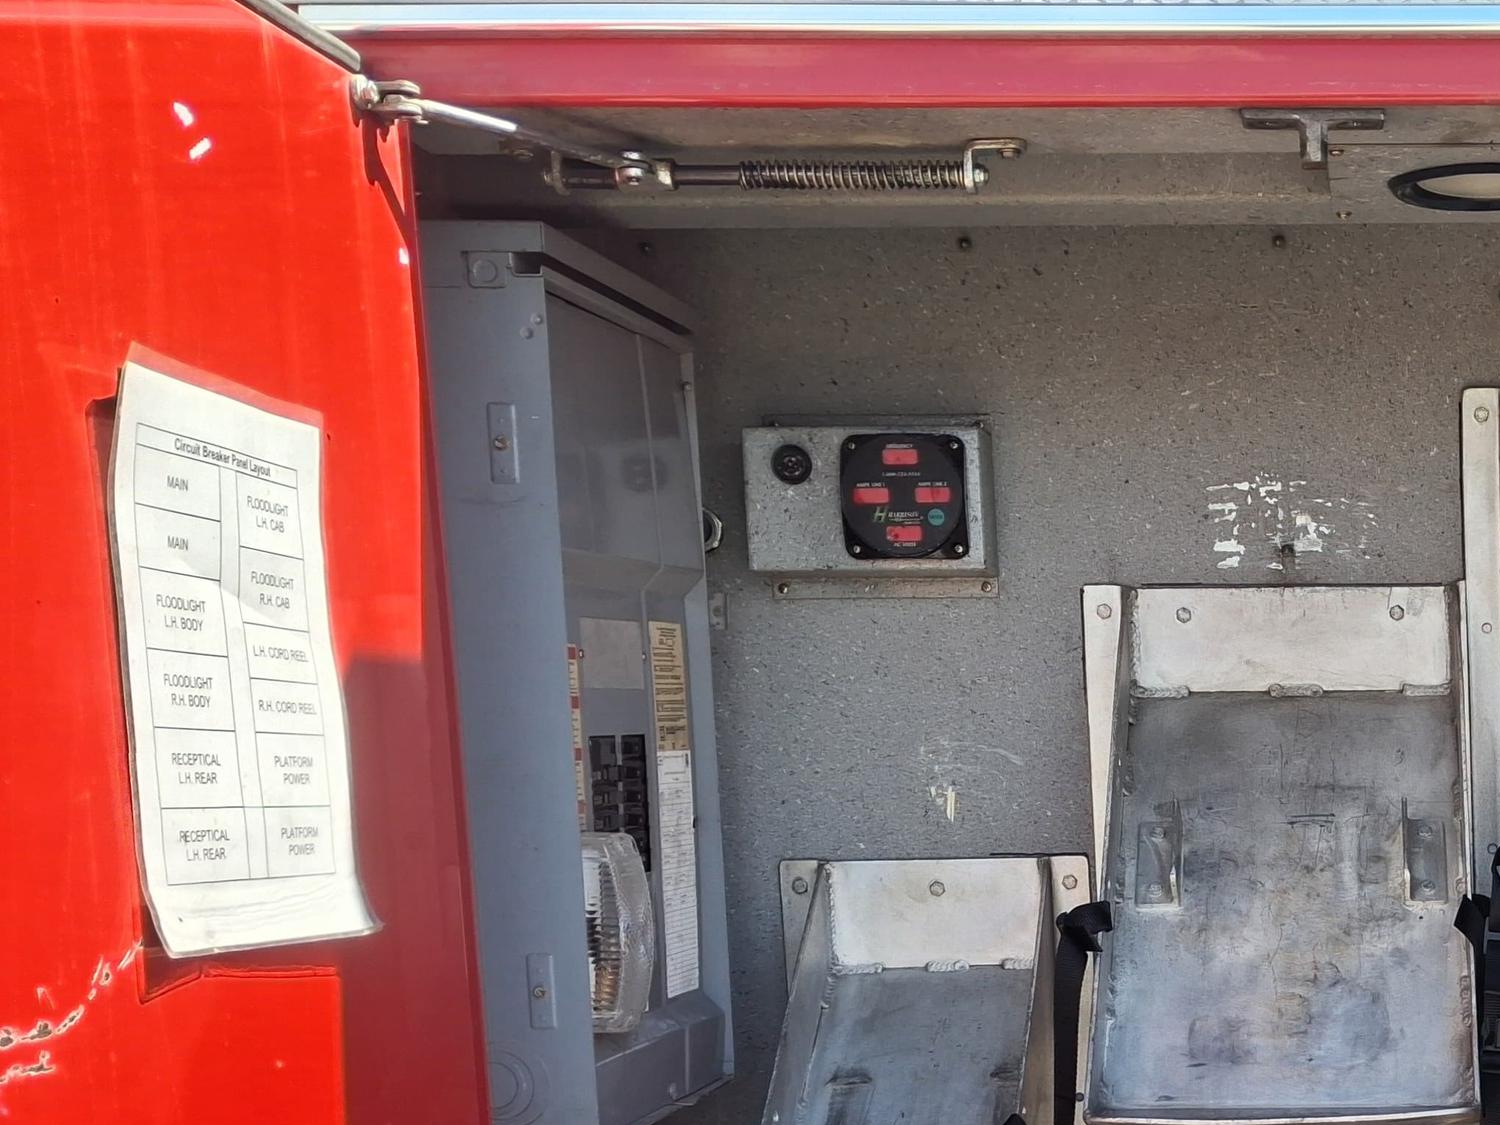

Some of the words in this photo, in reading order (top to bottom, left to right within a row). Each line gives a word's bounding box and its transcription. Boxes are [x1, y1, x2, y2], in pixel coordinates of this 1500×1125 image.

[174, 437, 201, 456] Circuit
[202, 444, 230, 464] Breaker
[231, 453, 249, 470] Panel
[249, 460, 271, 477] Layout
[167, 475, 189, 492] MAIN
[246, 495, 289, 518] FLOODLIGHT
[270, 519, 285, 534] CAB
[167, 535, 189, 551] MAIN
[250, 570, 294, 591] FLOODLIGHT
[156, 594, 206, 614] FLOODLIGHT
[275, 595, 291, 610] CAB
[180, 617, 204, 632] BODY
[268, 647, 290, 661] CORD
[290, 650, 310, 663] REEL
[163, 673, 213, 690] FLOODLIGHT
[171, 693, 187, 706] R.H.
[188, 694, 211, 708] BODY
[258, 699, 274, 712] R.H.
[275, 701, 298, 715] CORD
[298, 703, 318, 715] REEL
[171, 752, 221, 767] RECEPTICAL
[274, 755, 313, 769] PLATFORM
[178, 772, 193, 784] L.H.
[194, 772, 218, 785] REAR
[283, 772, 311, 785] POWER
[179, 828, 230, 844] RECEPTICAL
[281, 826, 319, 840] PLATFORM
[186, 849, 201, 862] L.H.
[202, 847, 226, 861] REAR
[288, 843, 315, 856] POWER
